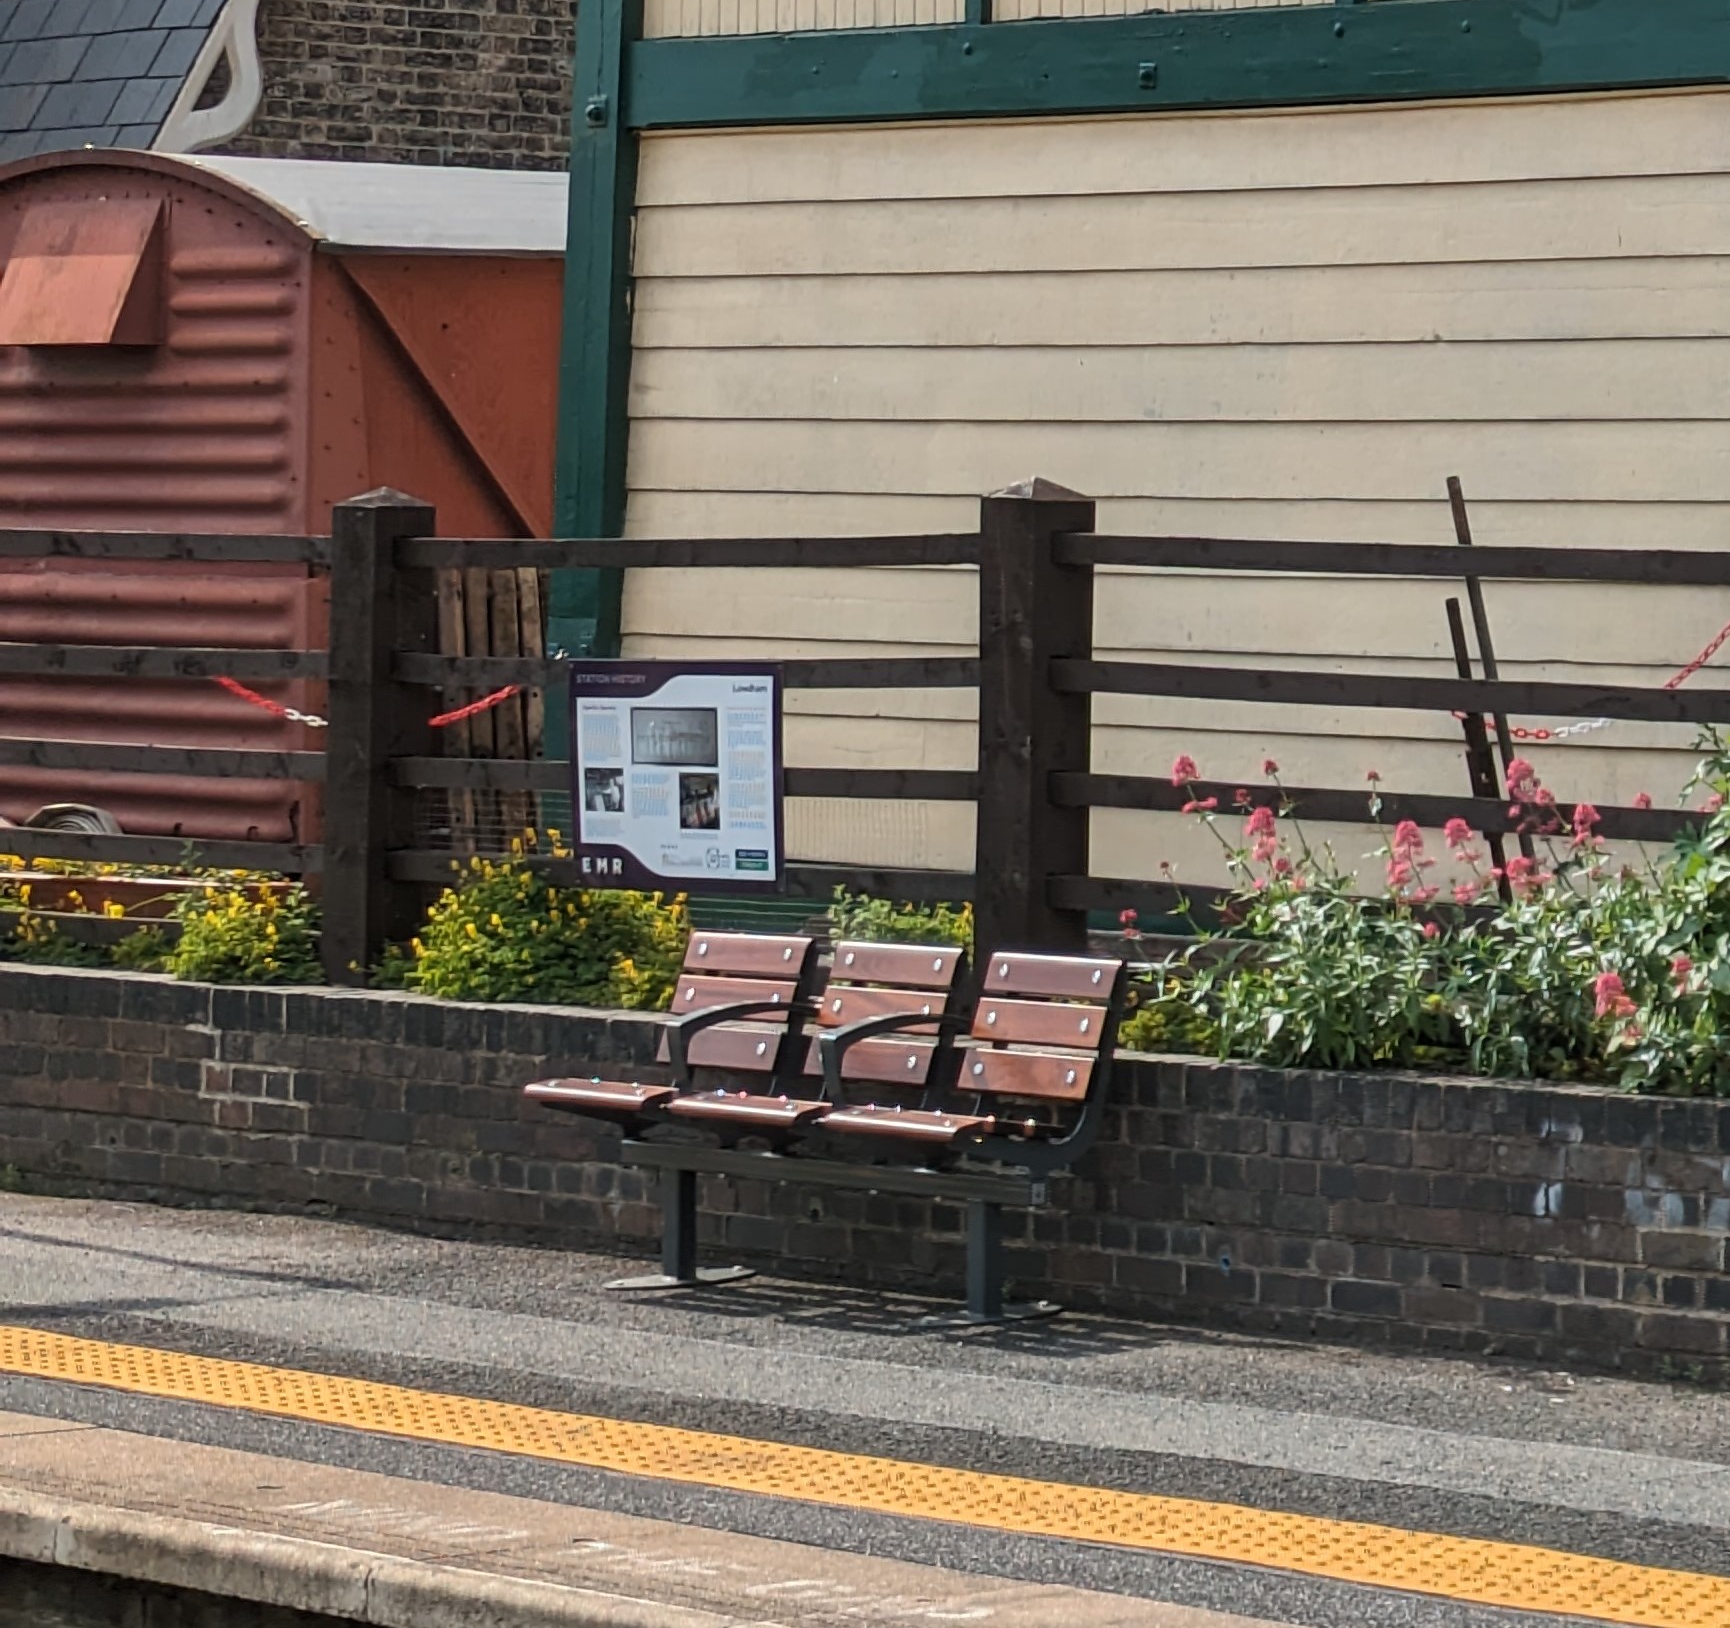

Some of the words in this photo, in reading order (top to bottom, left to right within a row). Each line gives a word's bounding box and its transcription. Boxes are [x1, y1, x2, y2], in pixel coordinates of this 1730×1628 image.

[576, 674, 610, 684] STATION
[732, 683, 768, 693] Lowdham
[582, 857, 623, 874] EMR
